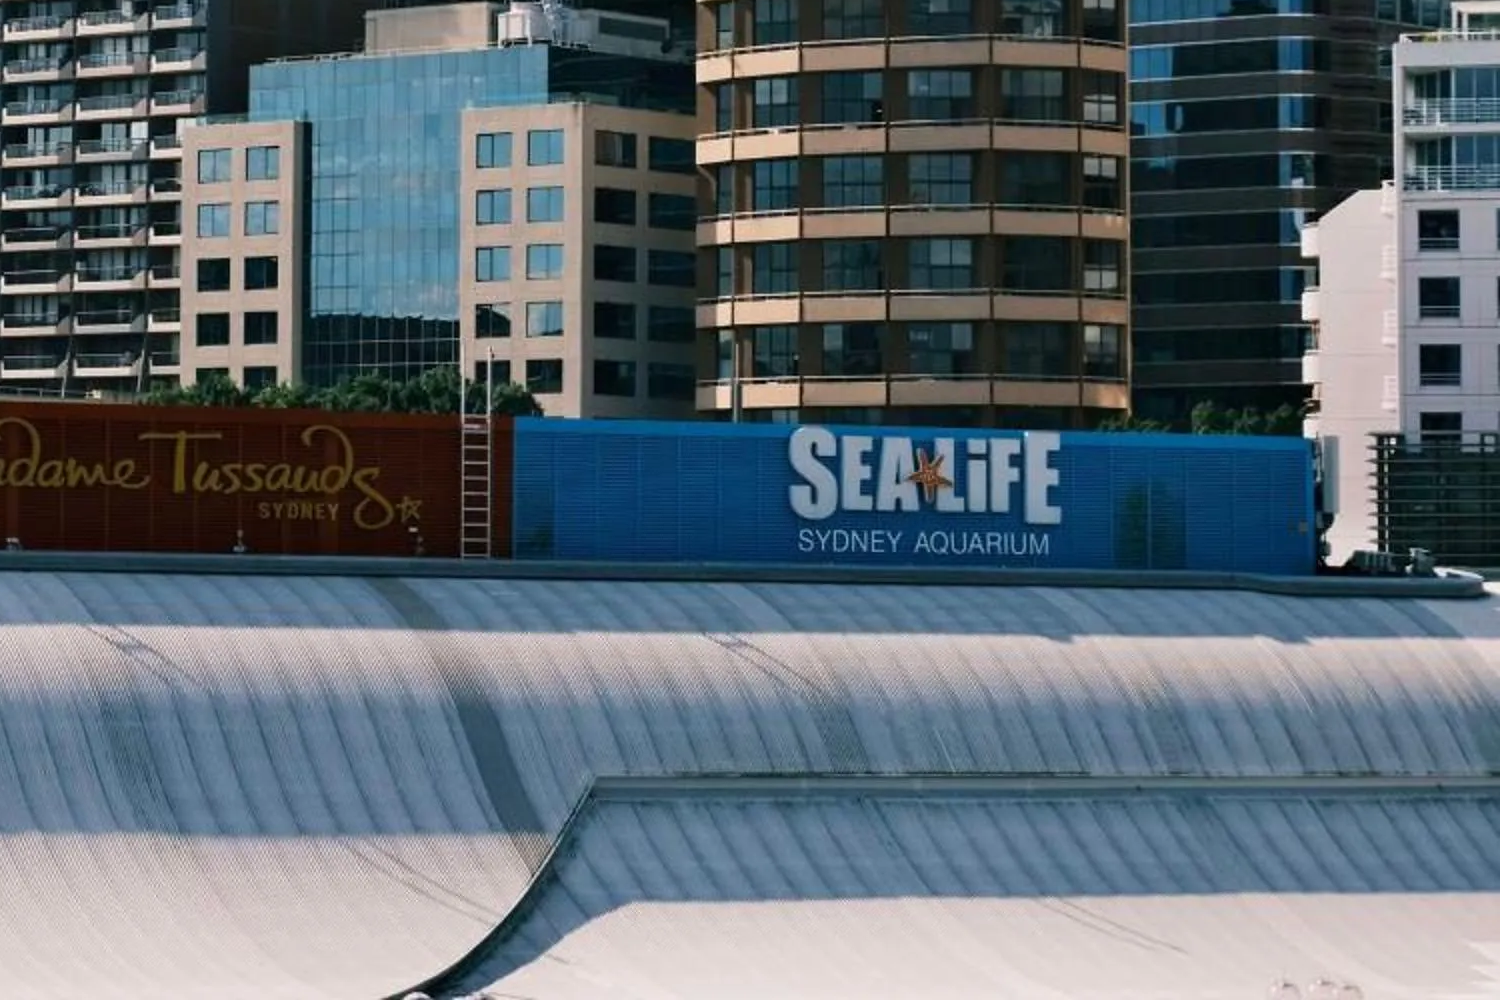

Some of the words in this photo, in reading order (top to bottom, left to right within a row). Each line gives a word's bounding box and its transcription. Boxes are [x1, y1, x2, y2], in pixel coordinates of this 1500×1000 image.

[138, 425, 395, 530] Tussauds
[788, 425, 921, 520] SEA
[258, 501, 339, 521] SYDNEY
[799, 528, 903, 553] SYDNEY
[914, 531, 1050, 556] AQUARIUM
